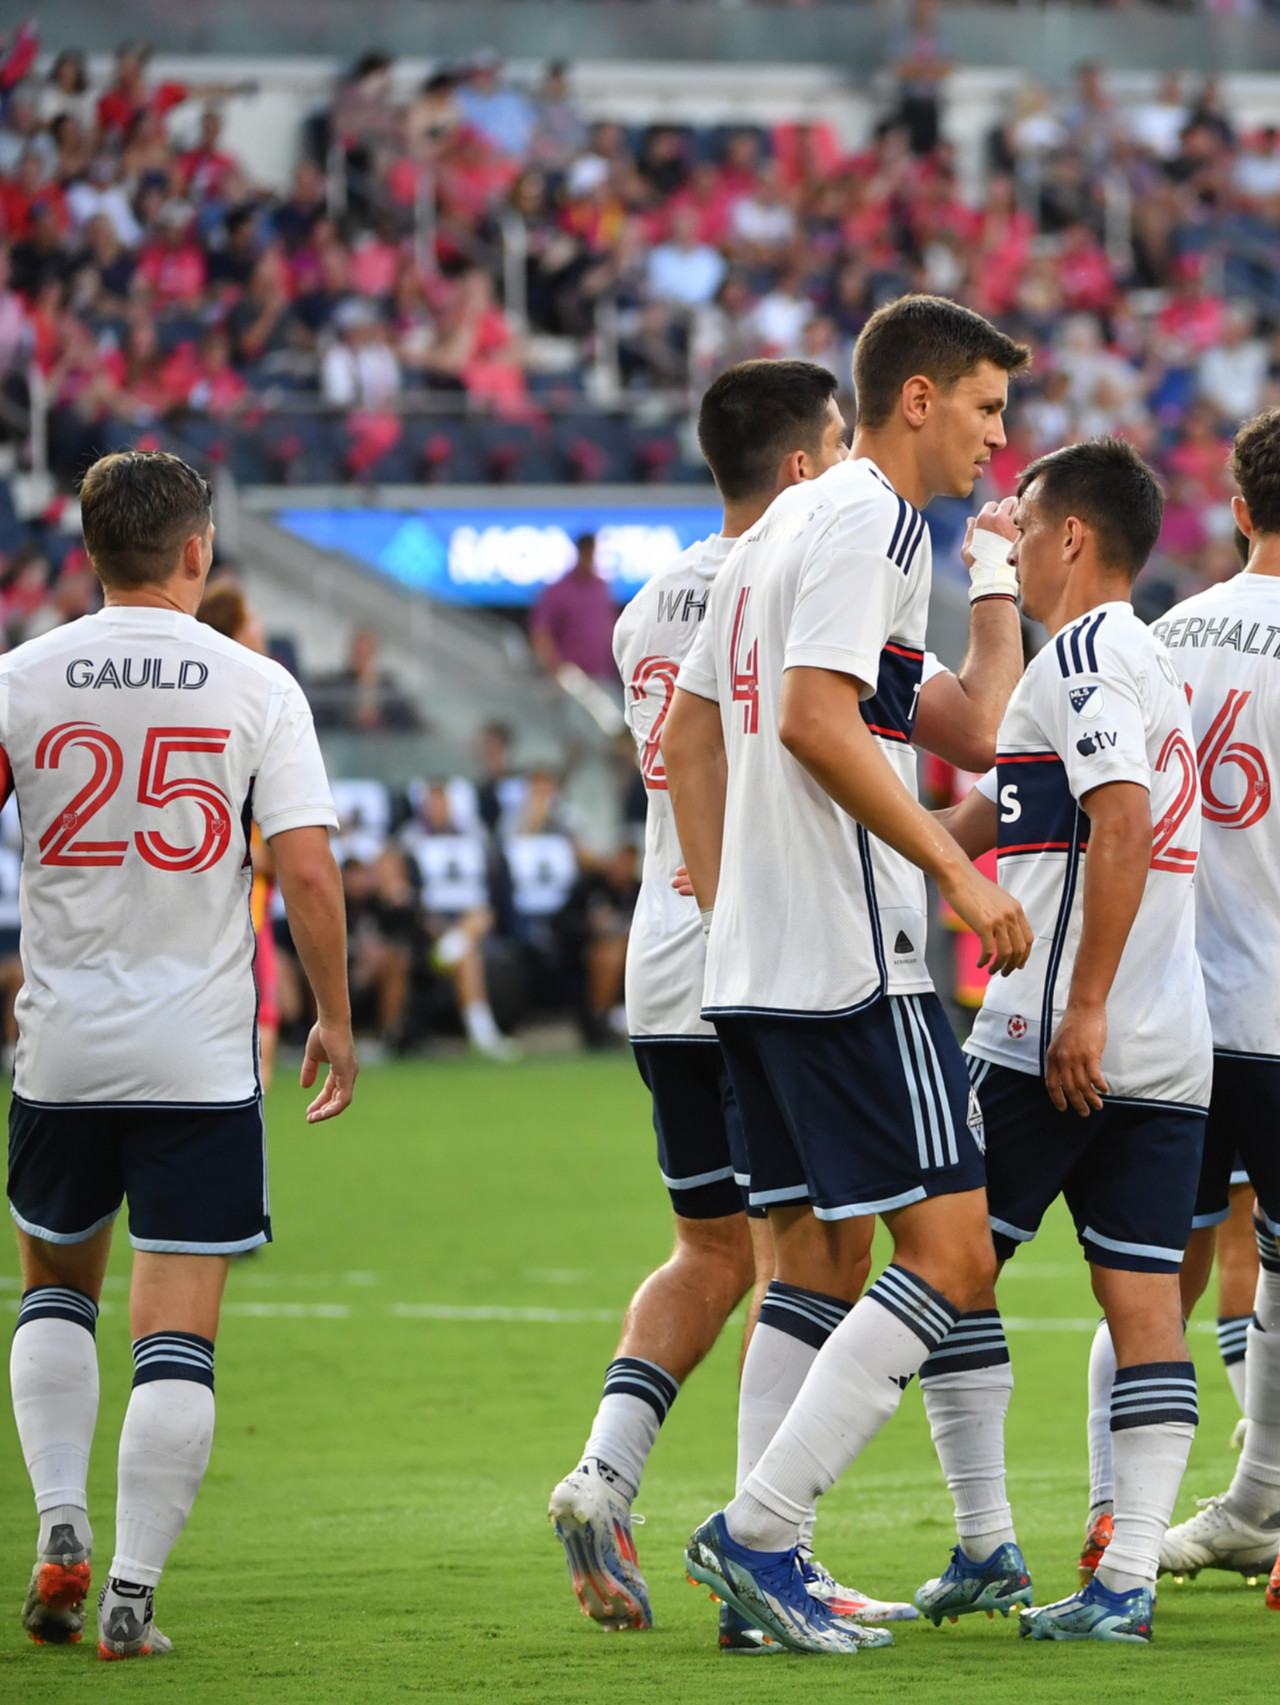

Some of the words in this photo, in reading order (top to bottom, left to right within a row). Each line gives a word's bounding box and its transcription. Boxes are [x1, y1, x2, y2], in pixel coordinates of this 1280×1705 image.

[66, 658, 209, 689] GAULD
[730, 586, 759, 734] 4
[1070, 688, 1090, 699] MLS
[1094, 730, 1117, 750] tv
[1184, 681, 1271, 830] 6
[35, 721, 232, 874] 25
